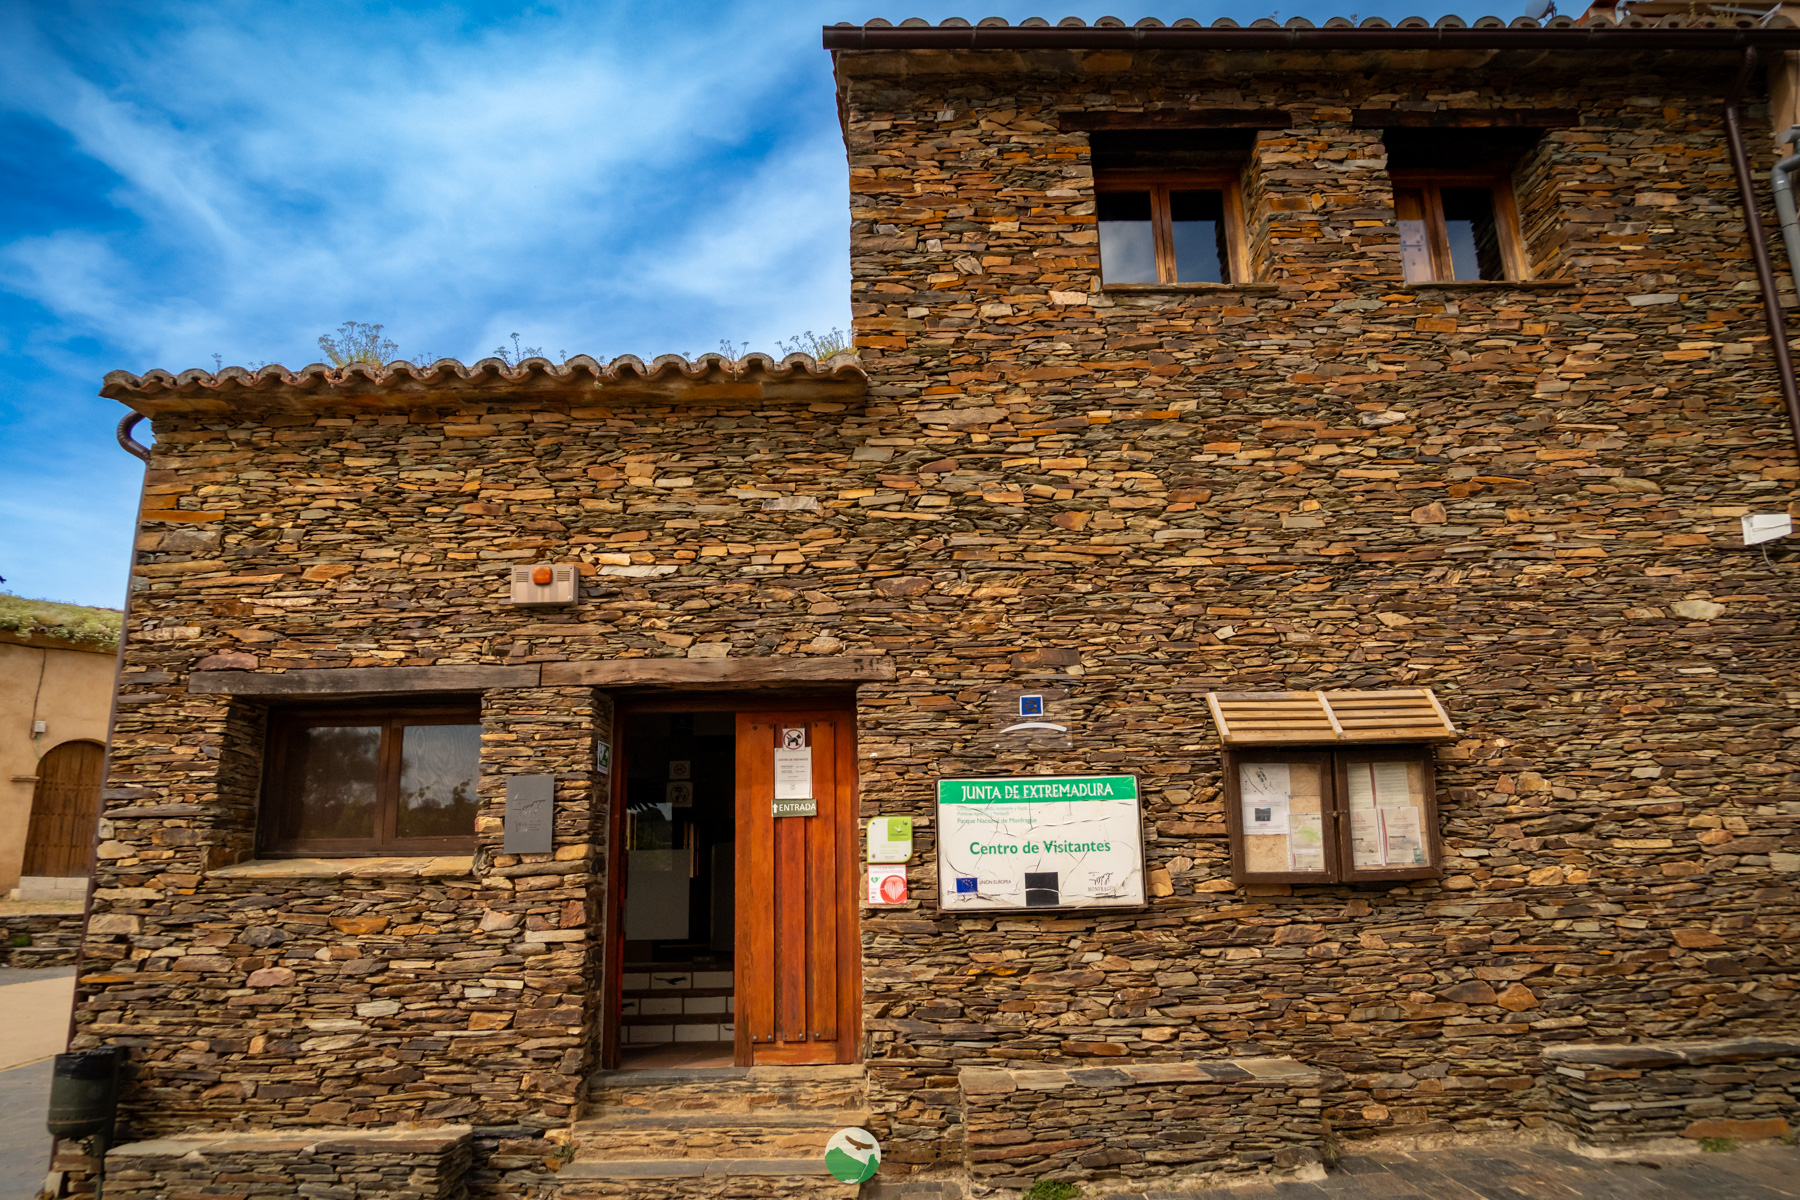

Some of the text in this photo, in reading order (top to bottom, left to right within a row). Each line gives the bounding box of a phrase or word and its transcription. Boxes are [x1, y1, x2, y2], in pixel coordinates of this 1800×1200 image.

[961, 783, 1114, 802] JUNTA DE EXTREMADURA
[779, 803, 816, 812] ENTRADA
[969, 840, 1111, 855] Centro de Visitantes
